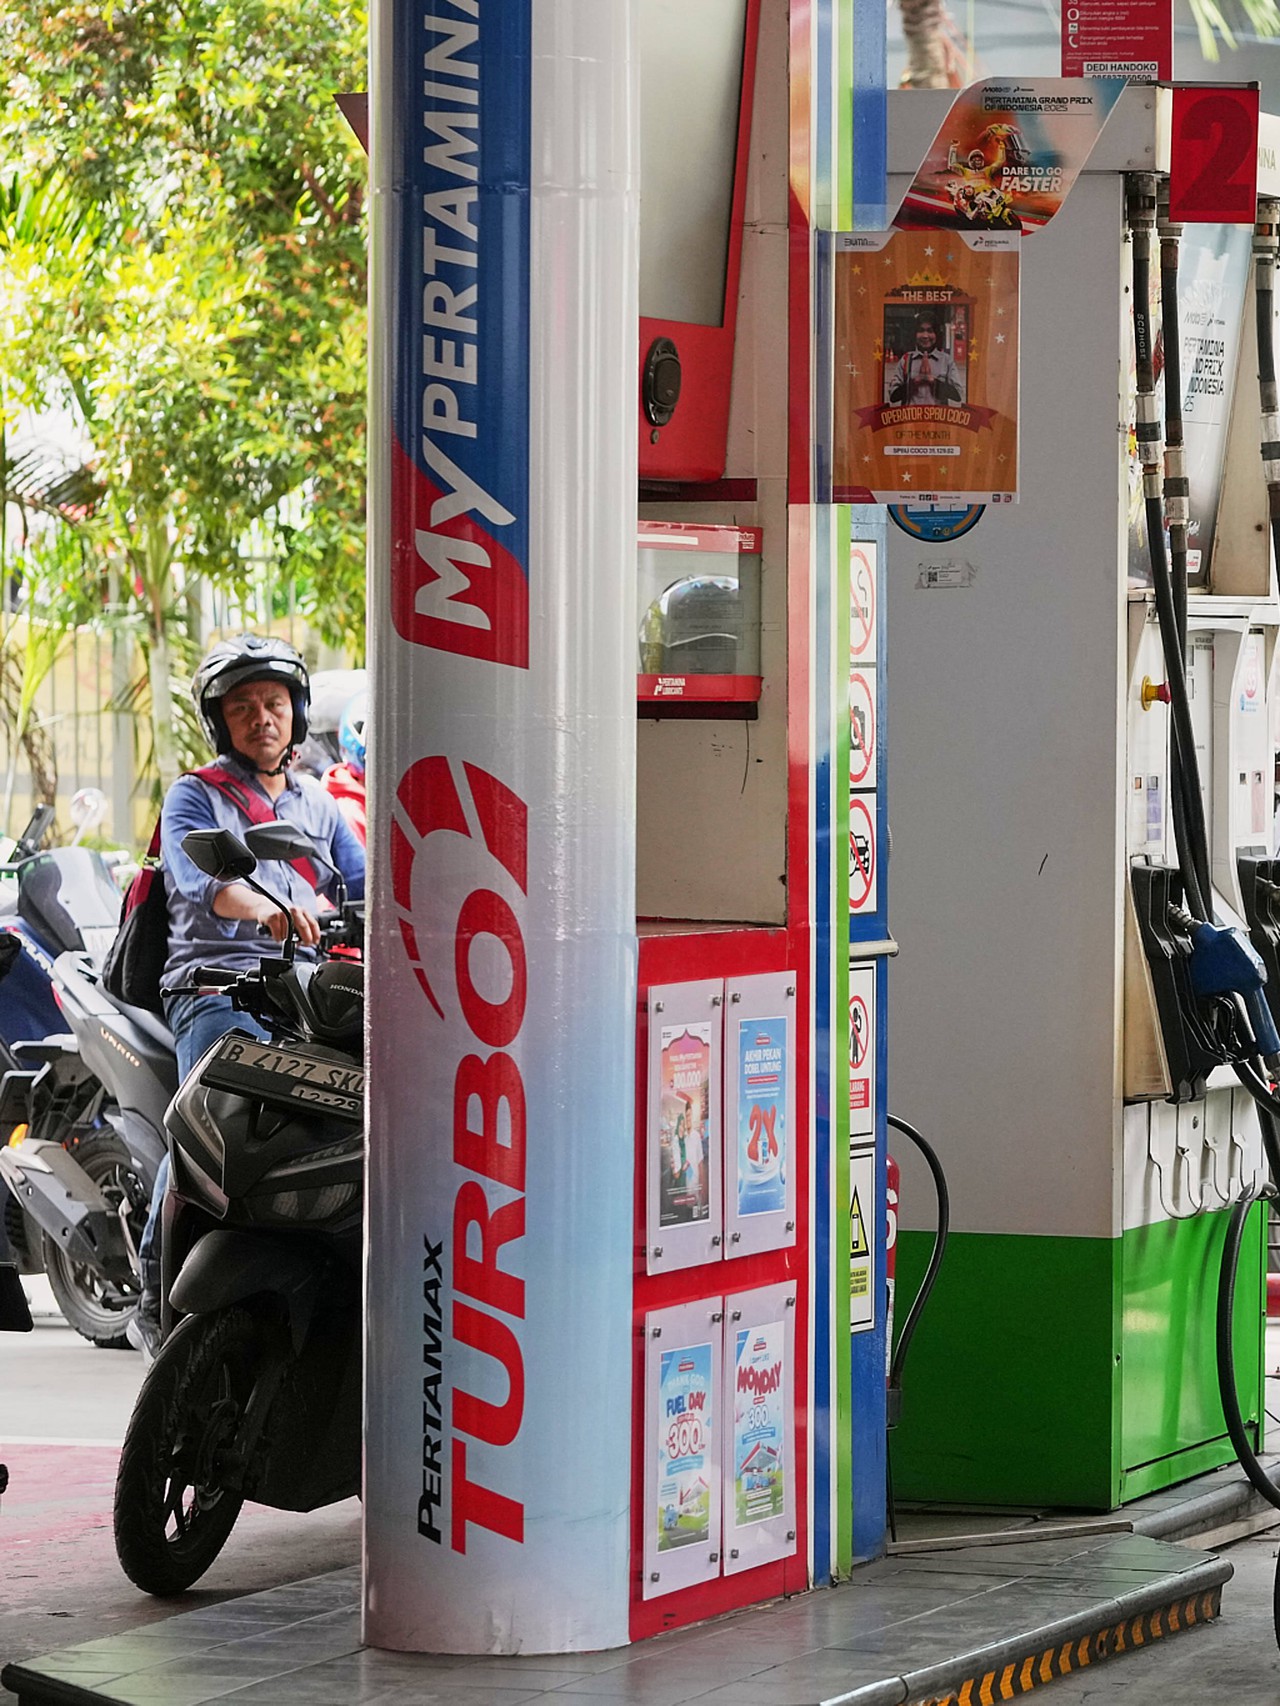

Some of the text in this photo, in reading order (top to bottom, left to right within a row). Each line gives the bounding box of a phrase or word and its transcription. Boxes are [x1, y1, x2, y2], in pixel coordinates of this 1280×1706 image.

[1086, 63, 1108, 71] DEDI
[1110, 63, 1157, 71] HANDOKO
[984, 96, 1093, 105] PERTAMINA GRAND PRIX
[984, 104, 1068, 112] OF INDONESIA 2025
[1174, 95, 1253, 211] 2
[1002, 167, 1062, 176] DARE TO GO
[1000, 176, 1062, 192] FASTER
[901, 290, 954, 302] THE BEST
[1204, 358, 1225, 377] PRIX
[881, 406, 971, 426] OPERATOR SPBU COCO
[924, 431, 951, 440] MONTH
[330, 984, 364, 998] HONDA
[228, 1043, 245, 1062] B
[252, 1053, 317, 1080] 4127
[450, 887, 528, 1556] TURBO
[737, 1360, 782, 1396] MONDAY
[417, 1233, 444, 1546] PERTAMAX
[666, 1395, 687, 1418] FUEL
[688, 1390, 706, 1411] DAY
[748, 1404, 769, 1431] 300
[668, 1418, 703, 1460] 300
